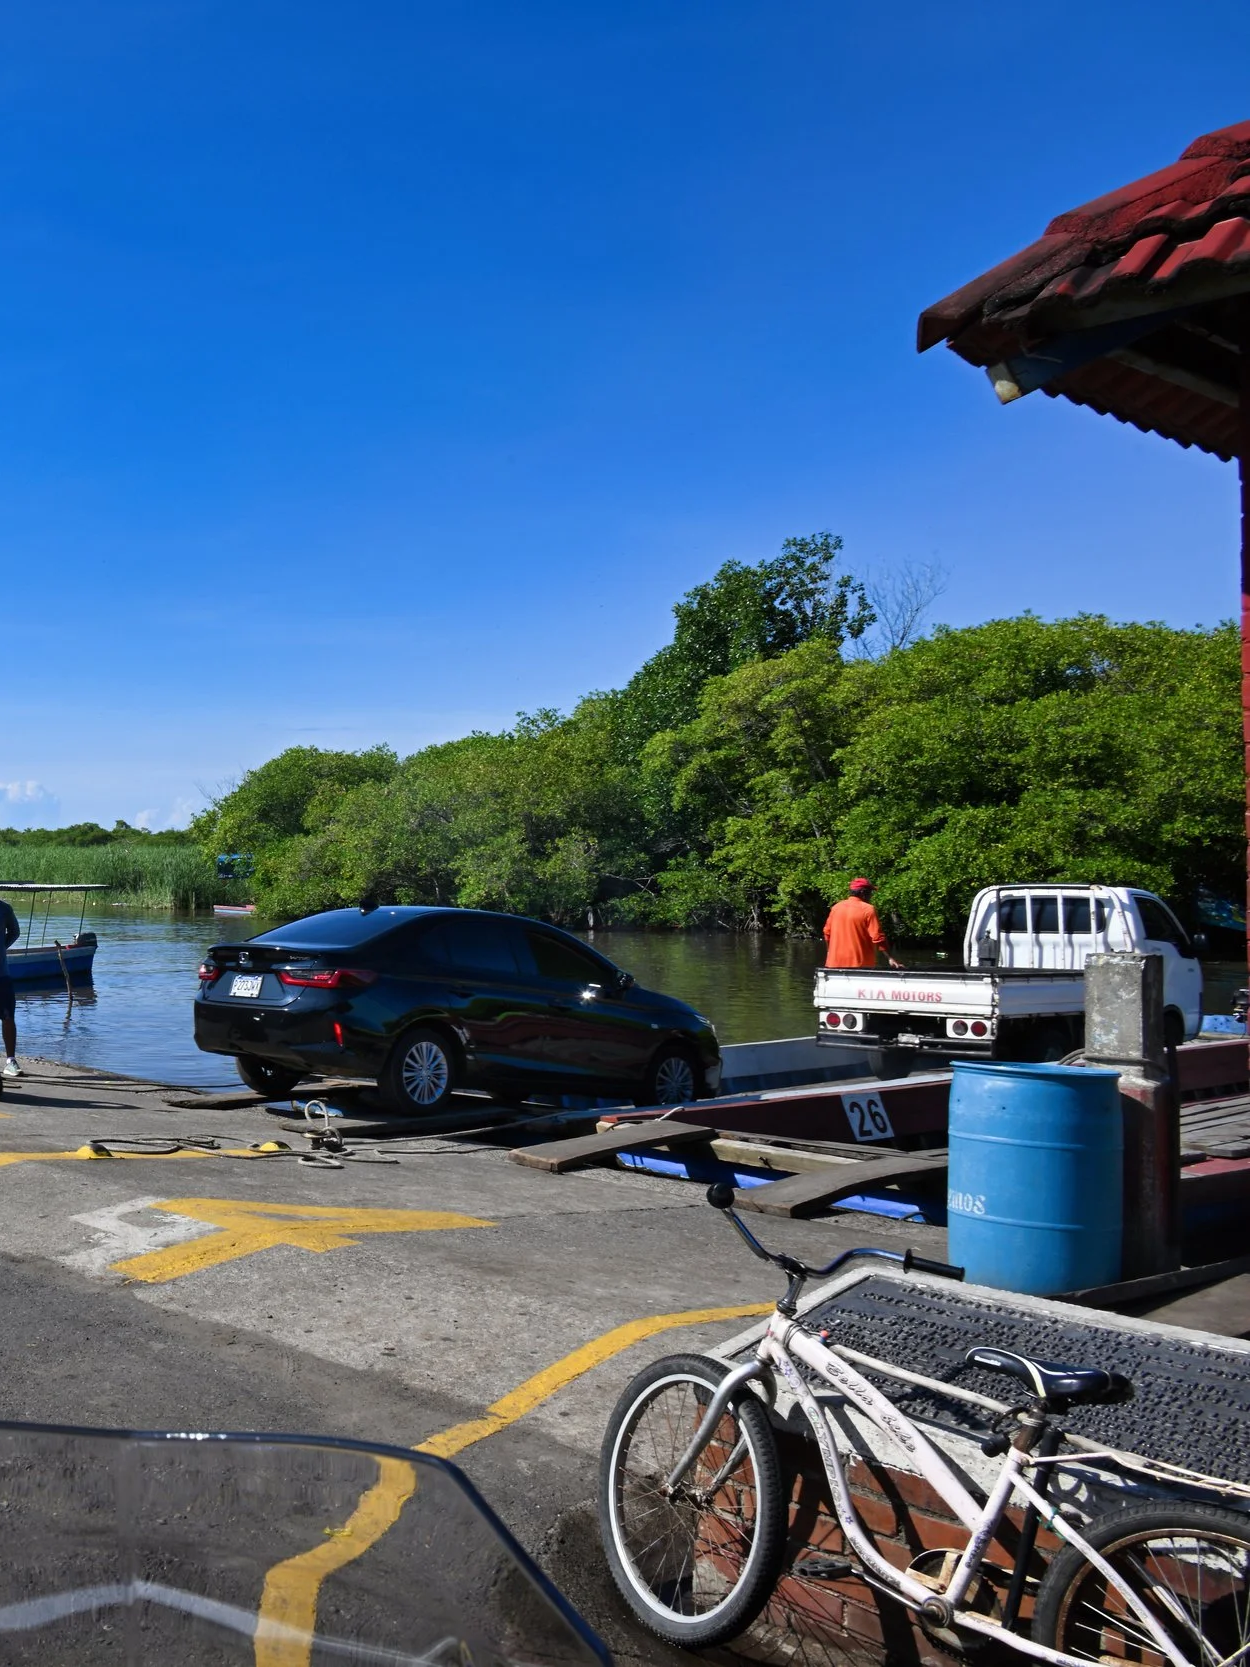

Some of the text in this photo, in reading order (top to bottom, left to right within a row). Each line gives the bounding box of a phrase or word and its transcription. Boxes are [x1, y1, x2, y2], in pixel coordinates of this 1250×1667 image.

[891, 990, 942, 1003] MOTORS
[849, 1099, 888, 1137] 26
[825, 1361, 874, 1406] Bella
